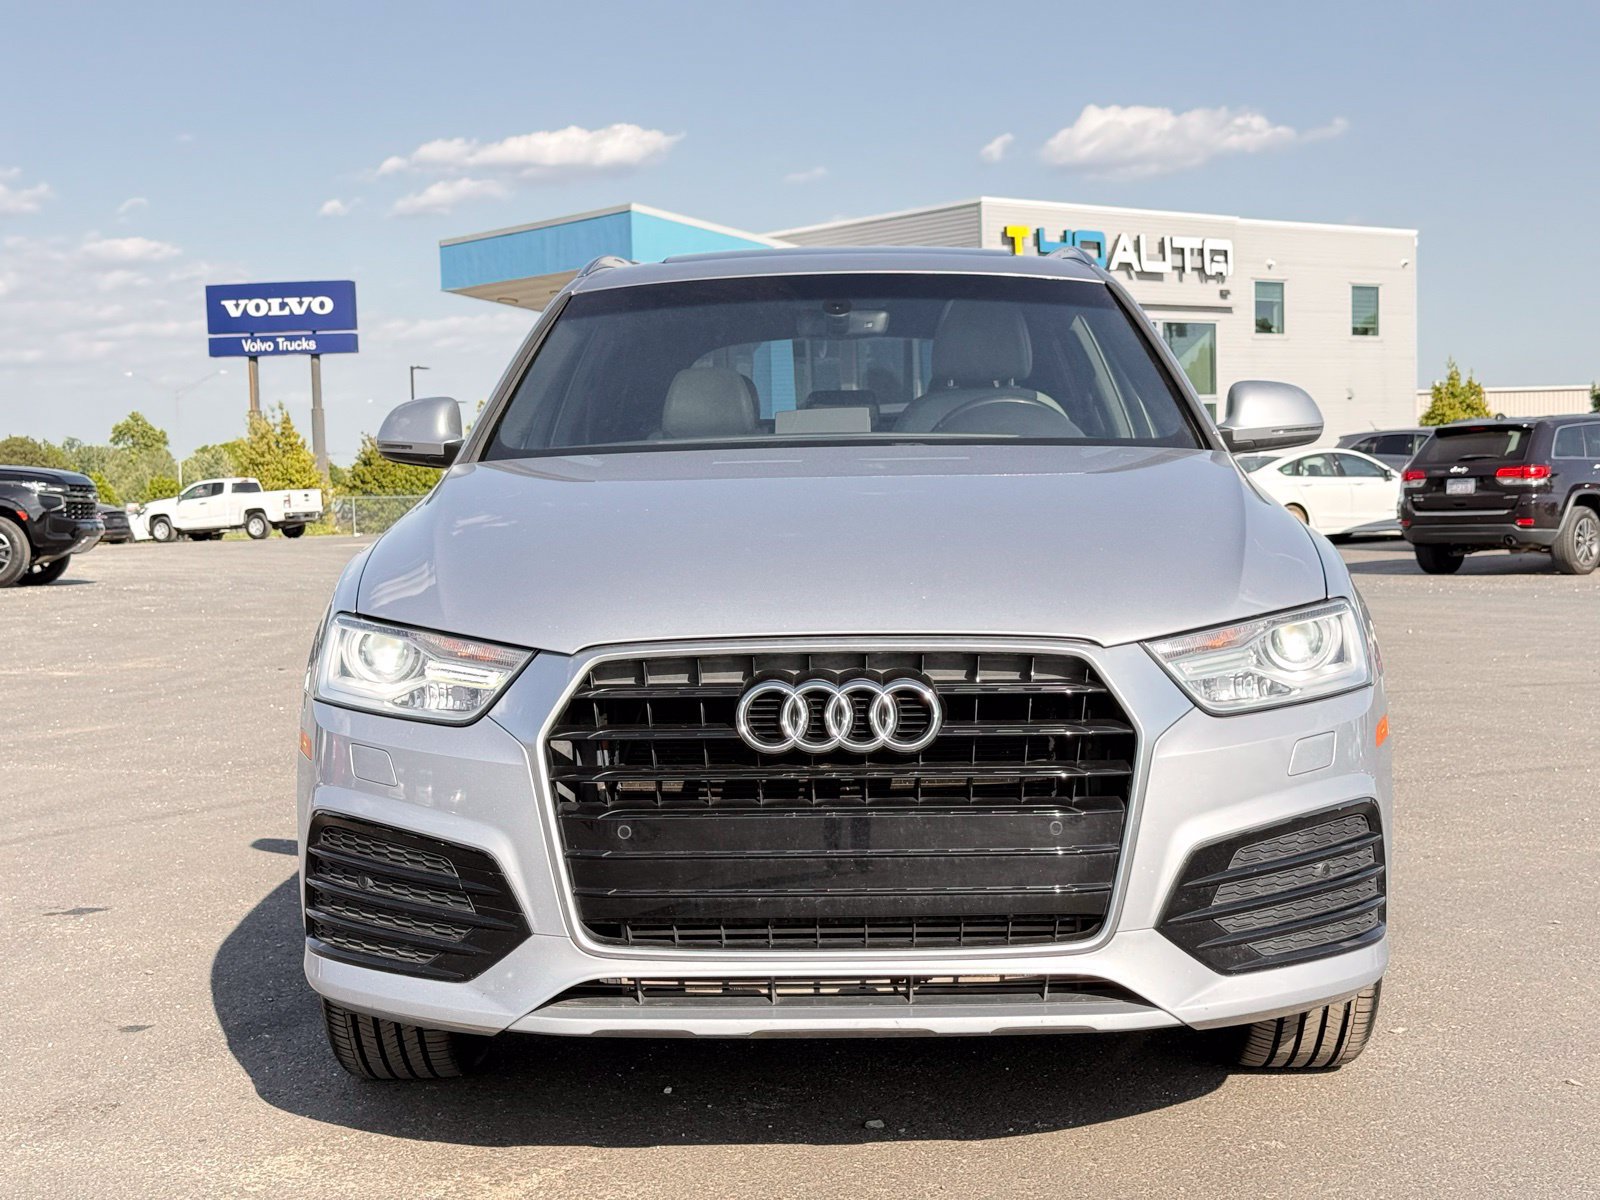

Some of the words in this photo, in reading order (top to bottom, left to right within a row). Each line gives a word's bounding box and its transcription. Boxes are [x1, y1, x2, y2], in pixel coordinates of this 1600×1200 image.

[220, 296, 334, 318] VOLVO
[241, 338, 274, 352] Volvo
[276, 337, 316, 351] Trucks
